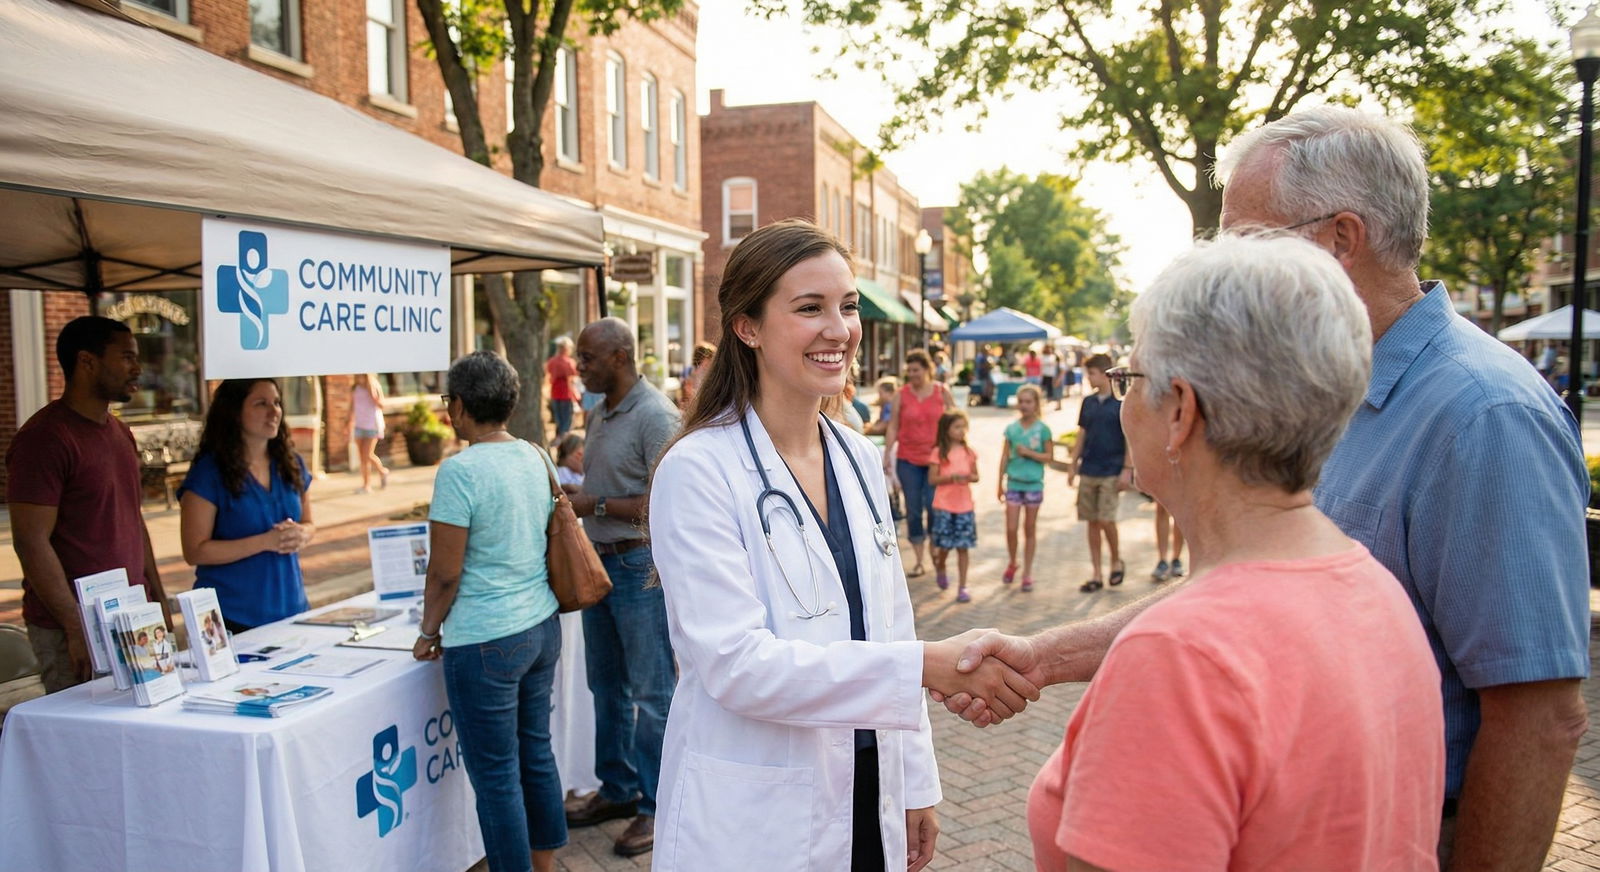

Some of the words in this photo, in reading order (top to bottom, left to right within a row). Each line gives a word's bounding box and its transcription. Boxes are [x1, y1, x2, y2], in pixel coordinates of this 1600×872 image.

[299, 258, 442, 297] COMMUNITY
[299, 301, 366, 331] CARE
[374, 304, 442, 333] CLINIC
